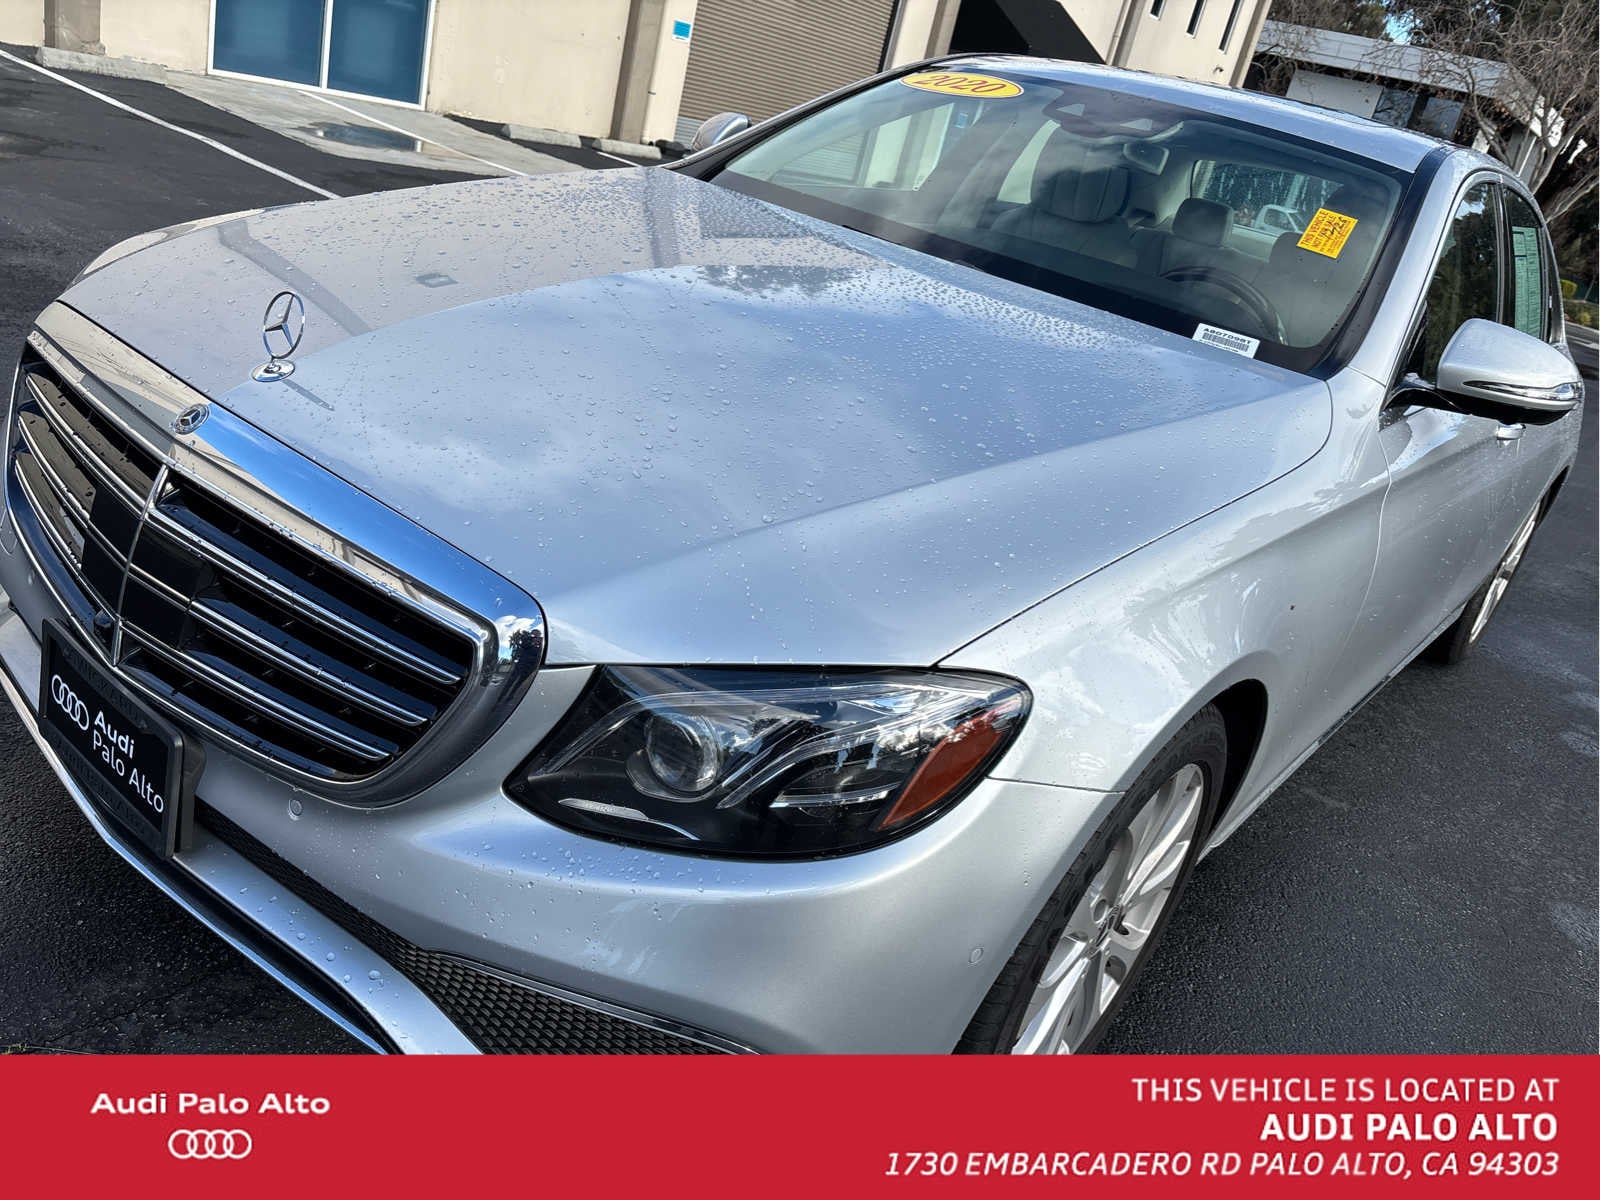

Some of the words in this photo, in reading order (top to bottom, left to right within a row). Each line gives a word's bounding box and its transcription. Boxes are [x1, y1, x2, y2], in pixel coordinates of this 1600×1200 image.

[912, 75, 1007, 93] 2020
[1300, 232, 1315, 246] THIS
[1308, 210, 1328, 233] VEHICLE
[1311, 236, 1323, 248] NOT
[94, 710, 135, 760] Audi
[92, 731, 125, 777] Palo
[128, 767, 165, 814] Alto
